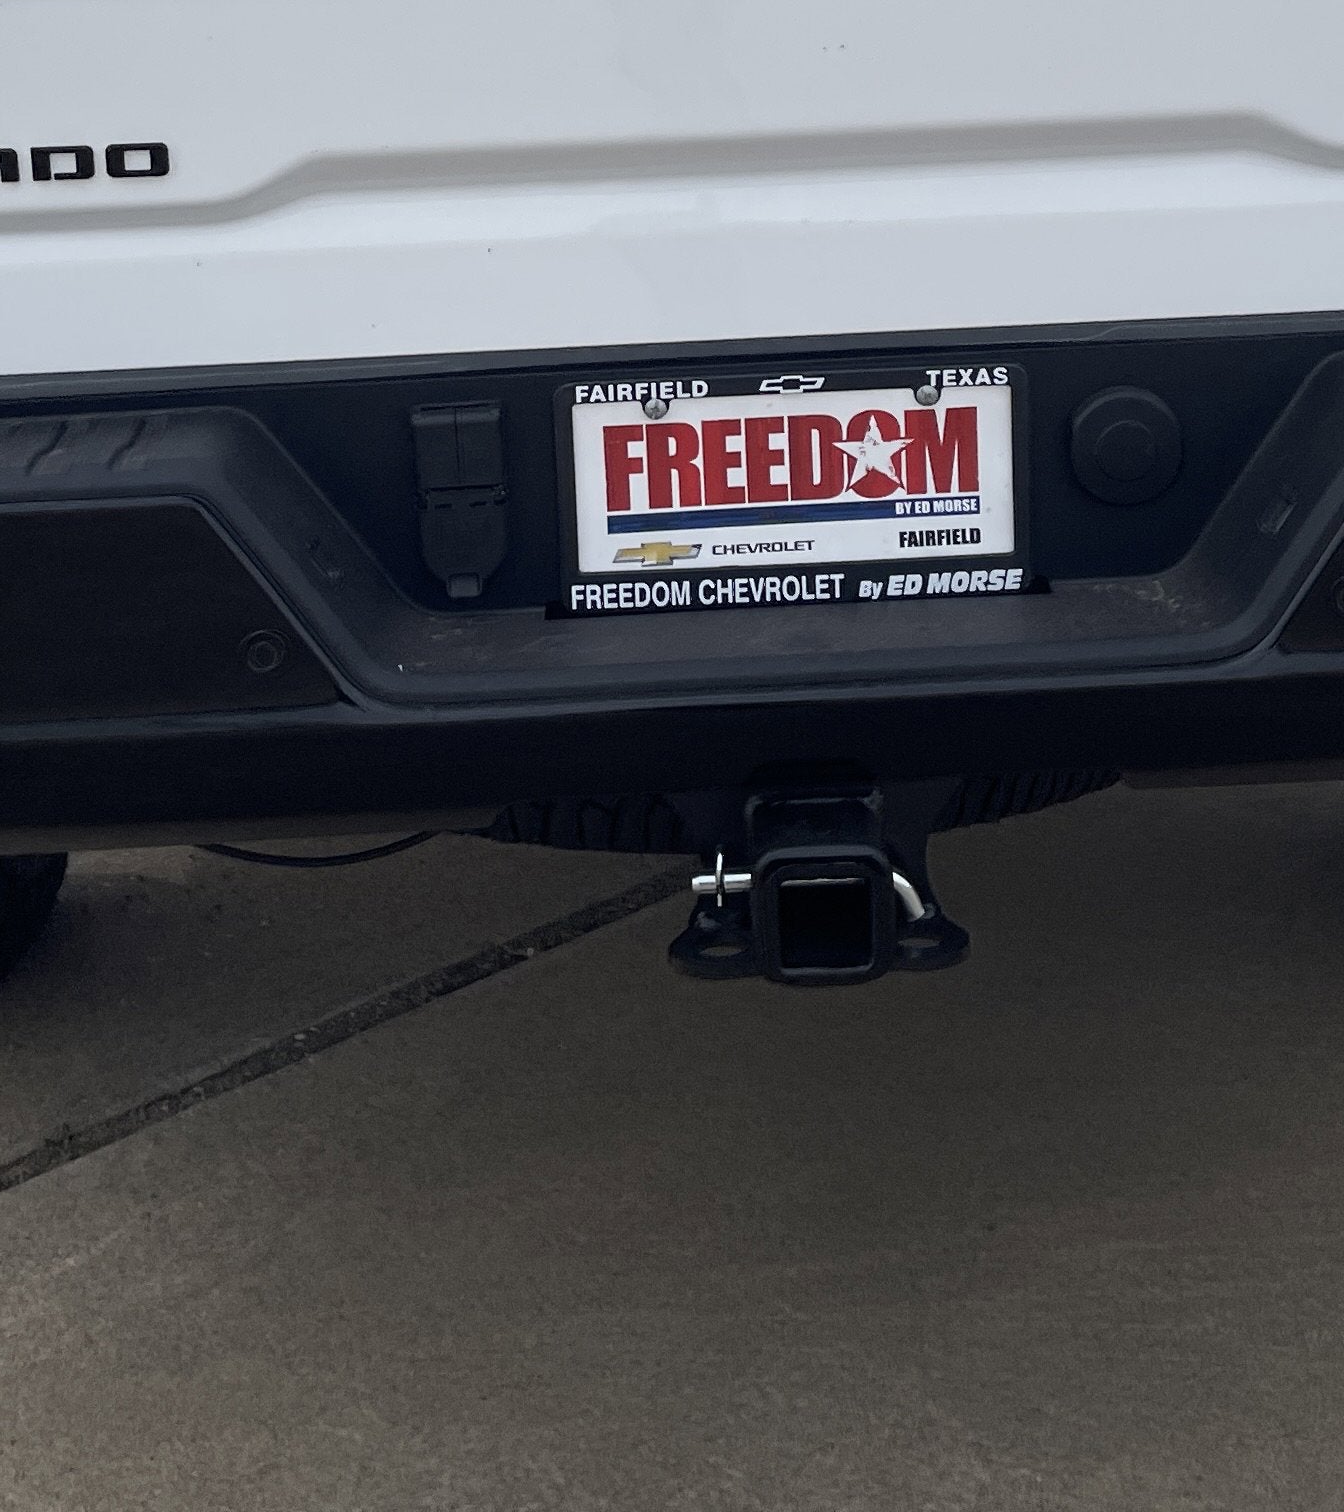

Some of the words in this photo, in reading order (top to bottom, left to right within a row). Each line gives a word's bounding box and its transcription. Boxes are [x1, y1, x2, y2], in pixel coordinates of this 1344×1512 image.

[926, 366, 1009, 388] TEXAS
[575, 380, 709, 404] FAIRFIELD
[602, 406, 980, 512] FREEDOM
[895, 499, 913, 514] BY
[914, 499, 930, 514] ED
[931, 497, 978, 513] MORSE
[711, 539, 815, 556] CHEVROLET
[898, 527, 982, 548] FAIRFIELD
[571, 578, 691, 611] FREEDOM
[698, 573, 845, 606] CHEVROLET
[859, 580, 883, 599] By
[886, 574, 922, 596] ED
[926, 568, 1023, 594] MORSE
